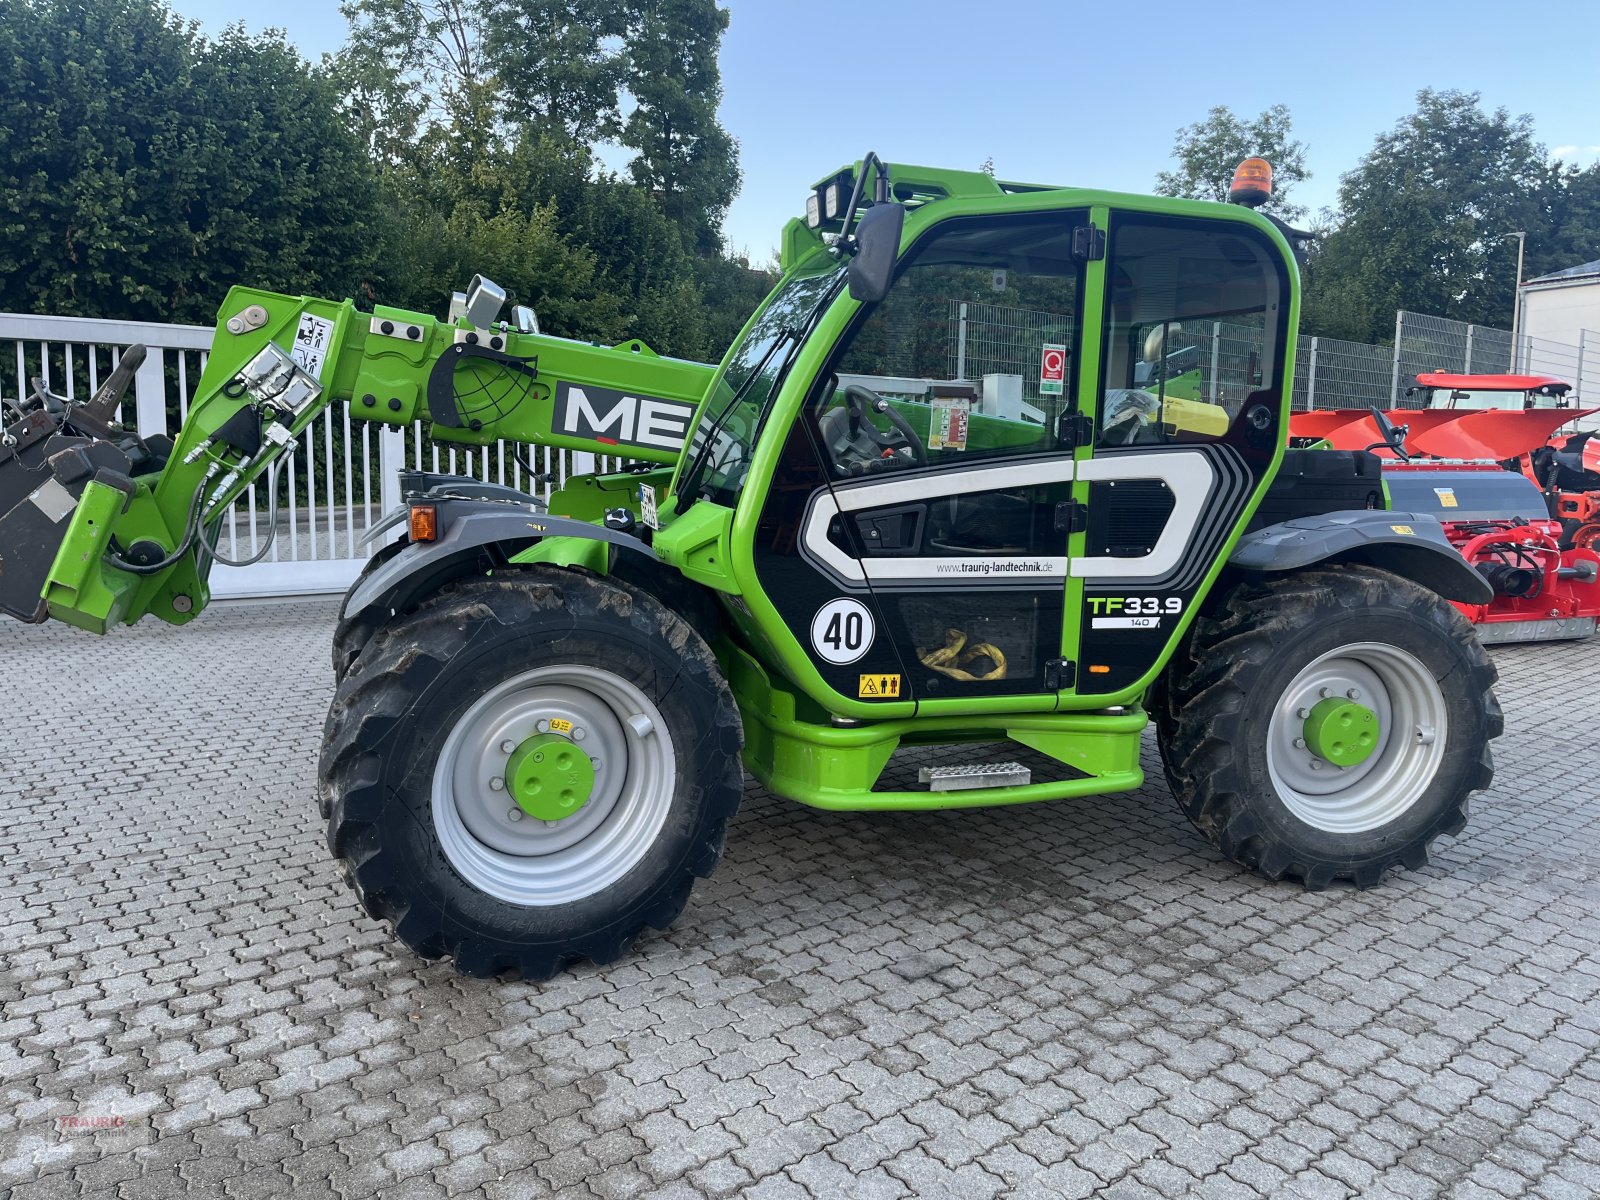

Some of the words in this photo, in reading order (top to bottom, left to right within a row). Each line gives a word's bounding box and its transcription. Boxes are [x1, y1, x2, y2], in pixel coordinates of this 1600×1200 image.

[936, 562, 1053, 574] www.traurig-landtechnik.de
[1087, 597, 1183, 614] TF33.9
[1131, 618, 1150, 627] 140
[823, 612, 863, 650] 40
